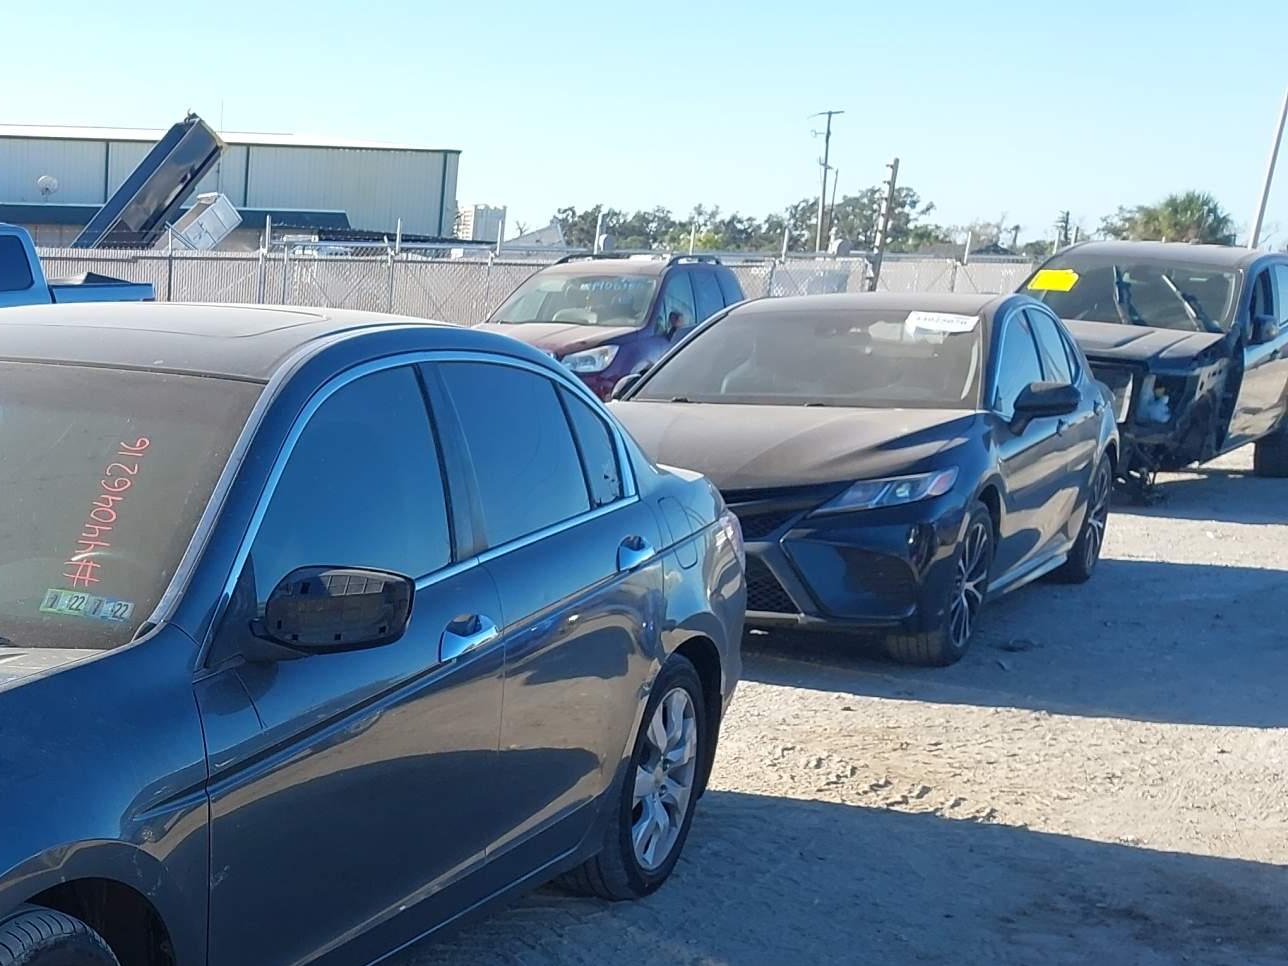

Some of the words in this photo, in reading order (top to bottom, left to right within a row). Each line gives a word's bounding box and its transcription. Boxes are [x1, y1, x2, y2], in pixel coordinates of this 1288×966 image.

[63, 436, 150, 588] #44046216
[68, 595, 86, 612] 22
[112, 602, 129, 619] 22
